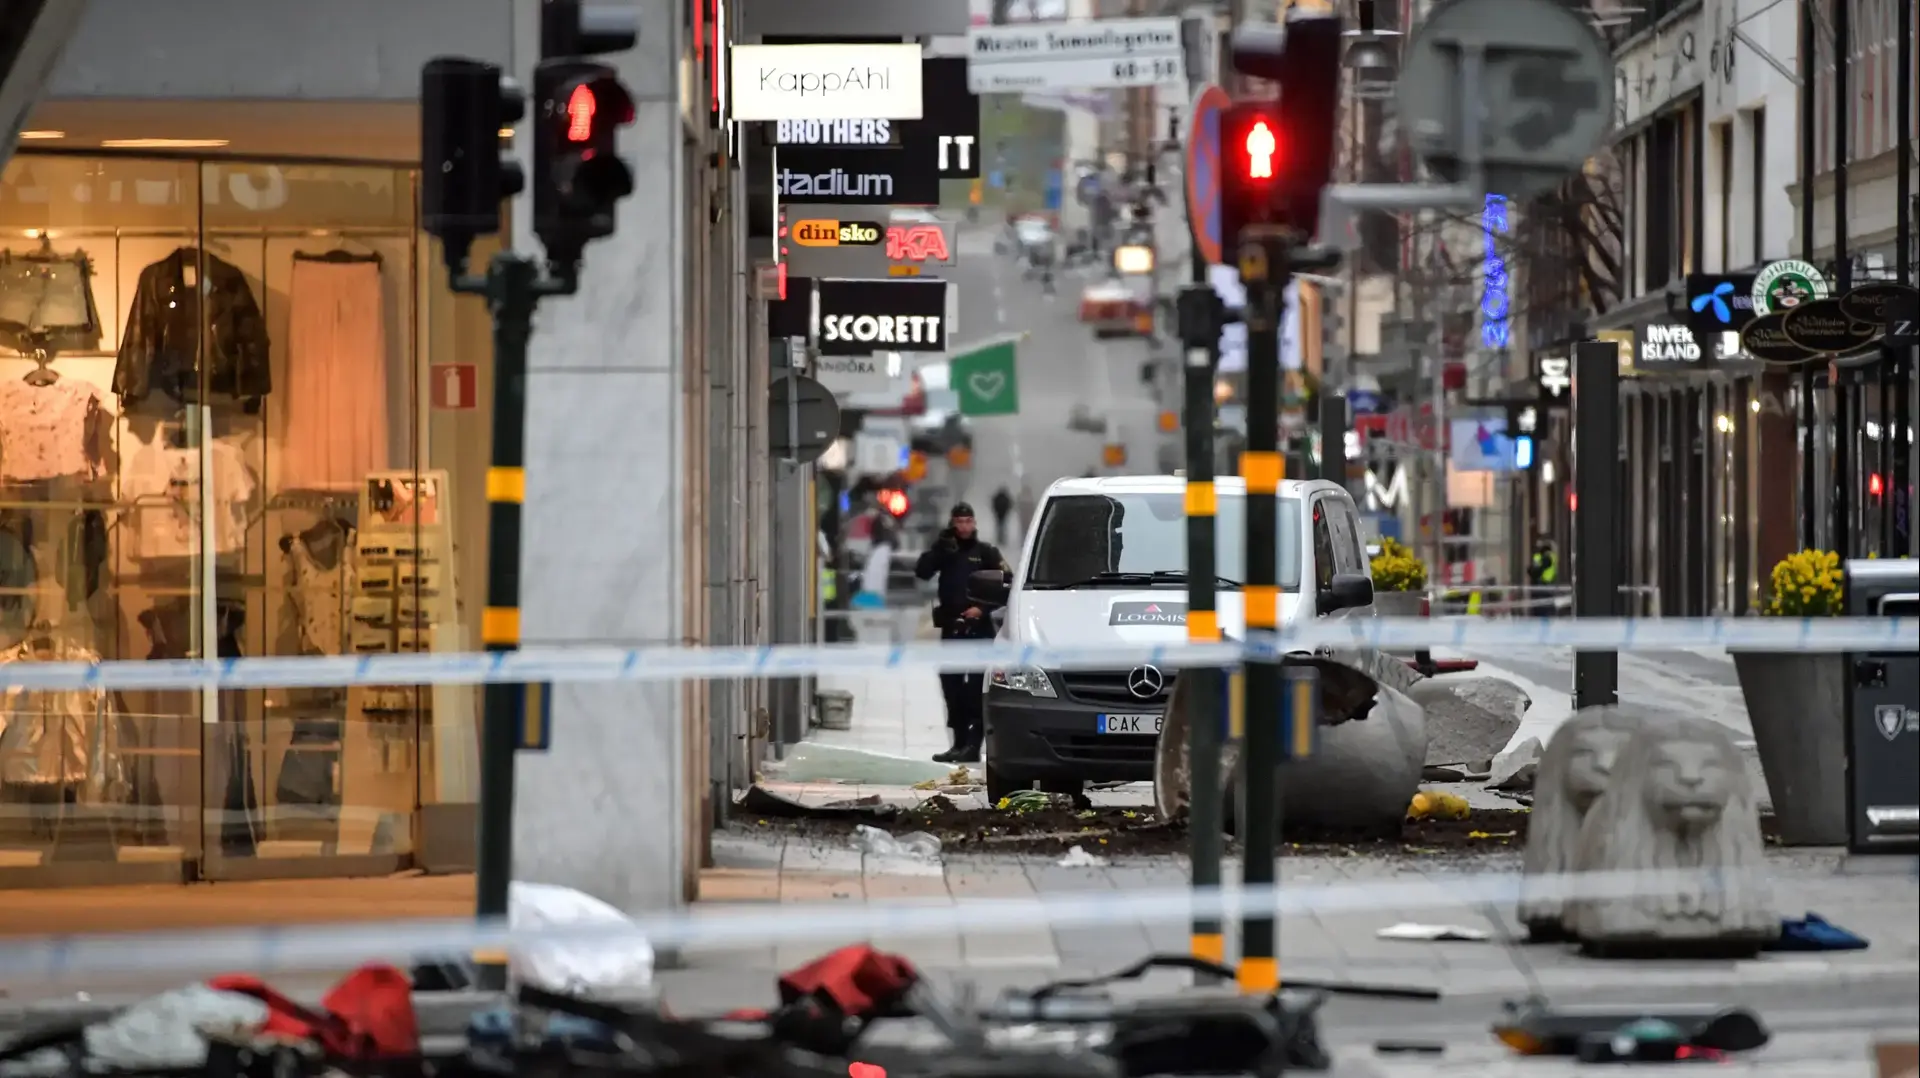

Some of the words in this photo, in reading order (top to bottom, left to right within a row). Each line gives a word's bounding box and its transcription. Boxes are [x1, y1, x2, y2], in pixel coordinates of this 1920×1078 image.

[760, 65, 890, 97] KappAhl
[777, 119, 890, 144] BROTHERS
[799, 223, 878, 242] dinsko
[824, 315, 940, 343] SCORETT
[1646, 324, 1694, 343] RIVER
[1893, 320, 1919, 336] Z
[1641, 342, 1701, 361] ISLAND
[1117, 612, 1188, 623] LOOMIS
[1108, 714, 1140, 733] CAK
